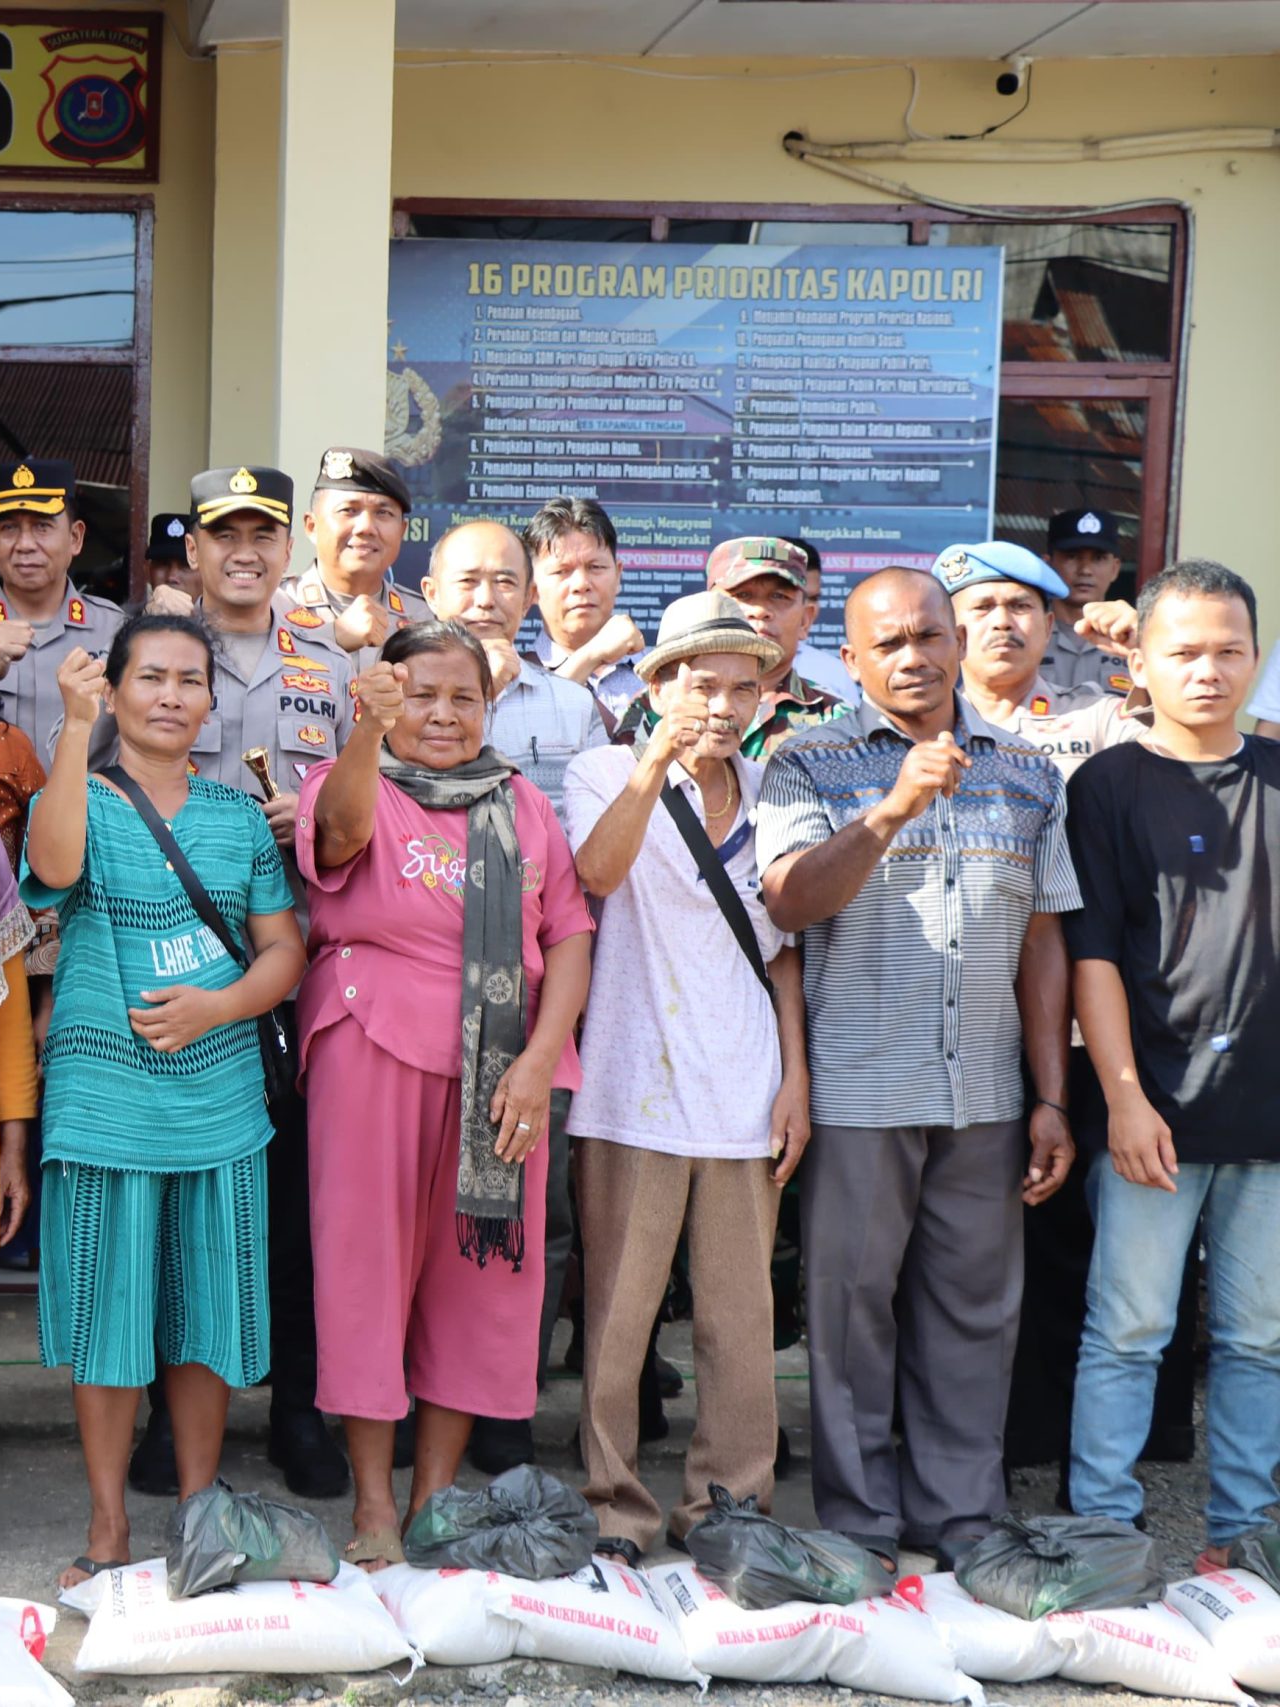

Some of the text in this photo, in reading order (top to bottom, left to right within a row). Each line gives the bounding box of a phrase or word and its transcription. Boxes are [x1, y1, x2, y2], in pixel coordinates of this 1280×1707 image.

[468, 263, 984, 302] 16 PROGRAM PRIORITAS KAPOLRI
[476, 305, 582, 322] 1. Penataan Kelembagaan.
[795, 310, 838, 324] Keamanan
[840, 310, 875, 326] Program
[878, 311, 915, 325] Prioritas
[917, 311, 954, 325] Nasional.
[474, 328, 658, 345] 2. Perubahan Sistem dan Metode Organisasi.
[753, 332, 795, 348] Penguatan
[473, 351, 482, 365] 3.
[486, 351, 533, 366] Menjadikan
[535, 351, 554, 365] SDM
[556, 352, 576, 365] Polri
[578, 352, 596, 367] Yang
[598, 353, 626, 367] Unggul
[628, 353, 636, 366] di
[638, 353, 652, 366] Era
[653, 353, 679, 366] Police
[752, 355, 801, 370] Peningkatan
[803, 356, 836, 369] Kualitas
[838, 356, 880, 370] Pelayanan
[882, 356, 907, 370] Publik
[473, 374, 481, 386] 4.
[485, 374, 529, 387] Perubahan
[531, 374, 568, 390] Teknologi
[648, 375, 656, 388] di
[658, 375, 672, 388] Era
[674, 375, 699, 388] Police
[805, 378, 847, 392] Pelayanan
[848, 379, 874, 392] Publik
[876, 379, 896, 392] Polri
[898, 380, 917, 393] Yang
[472, 396, 683, 411] 5. Pemantapan Kinerja Pemeliharaan Keamanan dan
[750, 400, 799, 415] Pemantapan
[484, 418, 526, 431] Ketertiban
[596, 420, 642, 430] TAPANULI
[644, 421, 683, 431] TENGAH
[749, 422, 800, 437] Pengawasan
[842, 423, 866, 436] Dalam
[868, 423, 894, 437] Setiap
[471, 440, 642, 456] 6. Peningkatan Kinerja Penegakan Hukum.
[748, 445, 791, 459] Penguatan
[792, 445, 819, 459] Fungsi
[471, 462, 478, 474] 7.
[483, 462, 532, 476] Pemantapan
[534, 463, 573, 477] Dukungan
[575, 464, 594, 477] Polri
[596, 464, 621, 477] Dalam
[623, 465, 672, 479] Penanganan
[748, 467, 798, 481] Pengawasan
[820, 468, 870, 482] Masyarakat
[871, 468, 903, 482] Pencari
[905, 469, 940, 482] Keadilan
[470, 484, 478, 496] 8.
[482, 484, 524, 497] Pemulihan
[800, 526, 901, 541] Menegakkan Hukum
[280, 695, 336, 719] POLRI
[1041, 740, 1091, 755] OLRI
[511, 1594, 658, 1644] BERAS KUKUBALAM C4 ASLI
[174, 1618, 243, 1640] KUKUBALAM
[247, 1617, 260, 1630] C4
[264, 1615, 290, 1630] ASLI
[717, 1628, 755, 1645] BERAS
[838, 1615, 864, 1634] ASLI
